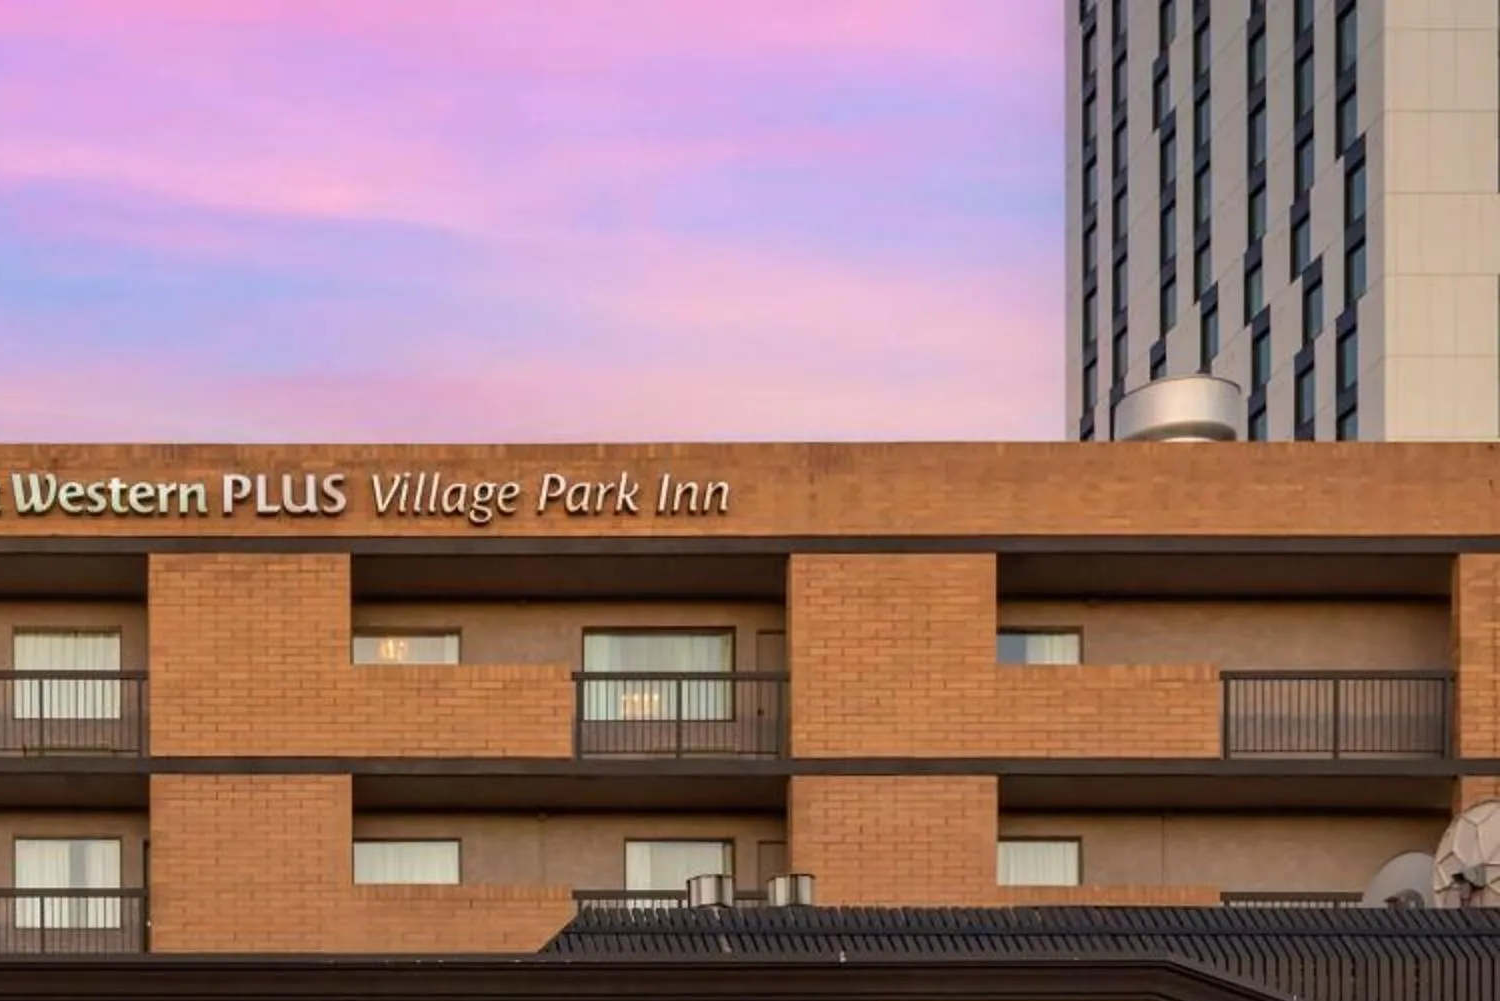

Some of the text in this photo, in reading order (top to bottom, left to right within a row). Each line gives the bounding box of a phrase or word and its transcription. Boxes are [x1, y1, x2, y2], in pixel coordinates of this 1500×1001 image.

[11, 472, 208, 514] Western
[222, 473, 347, 513] PLUS
[371, 473, 520, 524] Village
[537, 473, 640, 513] Park
[657, 474, 730, 512] Inn
